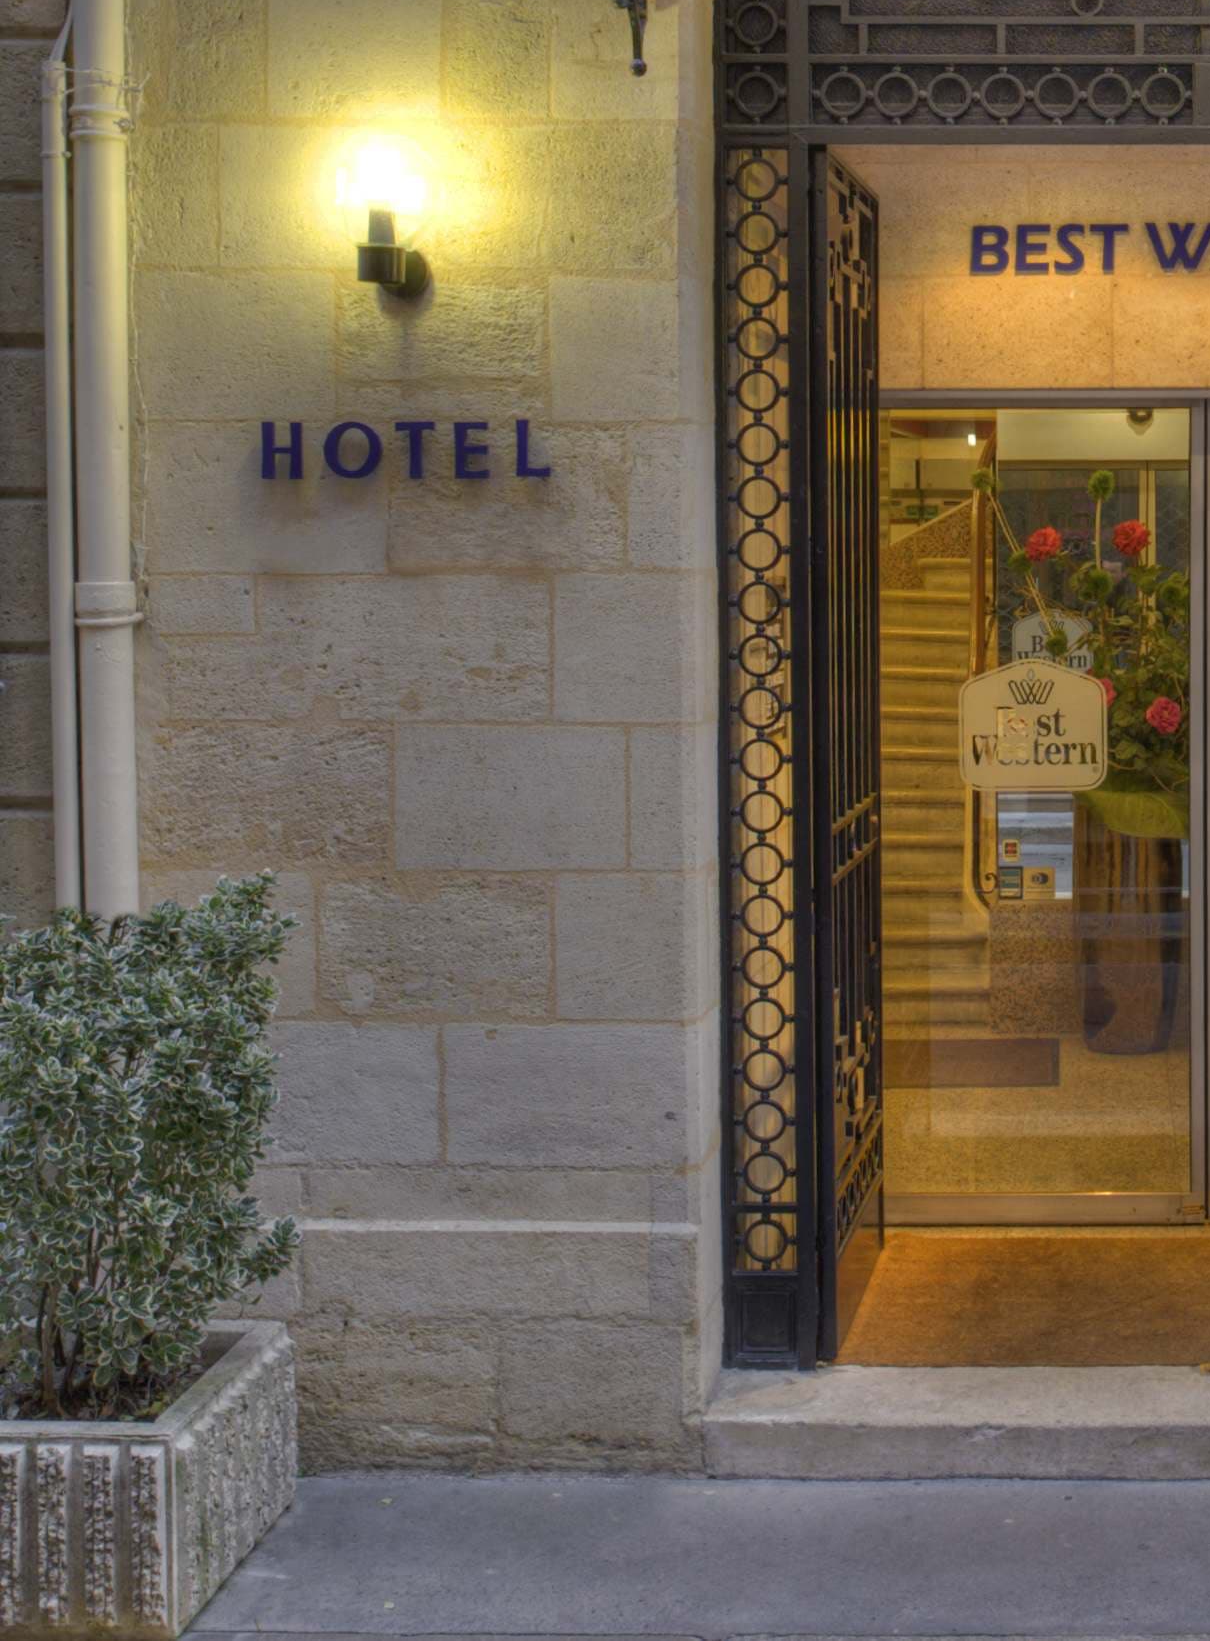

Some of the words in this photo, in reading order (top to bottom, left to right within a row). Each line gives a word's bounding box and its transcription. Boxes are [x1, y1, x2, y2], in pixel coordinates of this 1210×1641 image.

[969, 223, 1129, 276] BEST
[260, 419, 551, 480] HOTEL
[996, 707, 1067, 737] st
